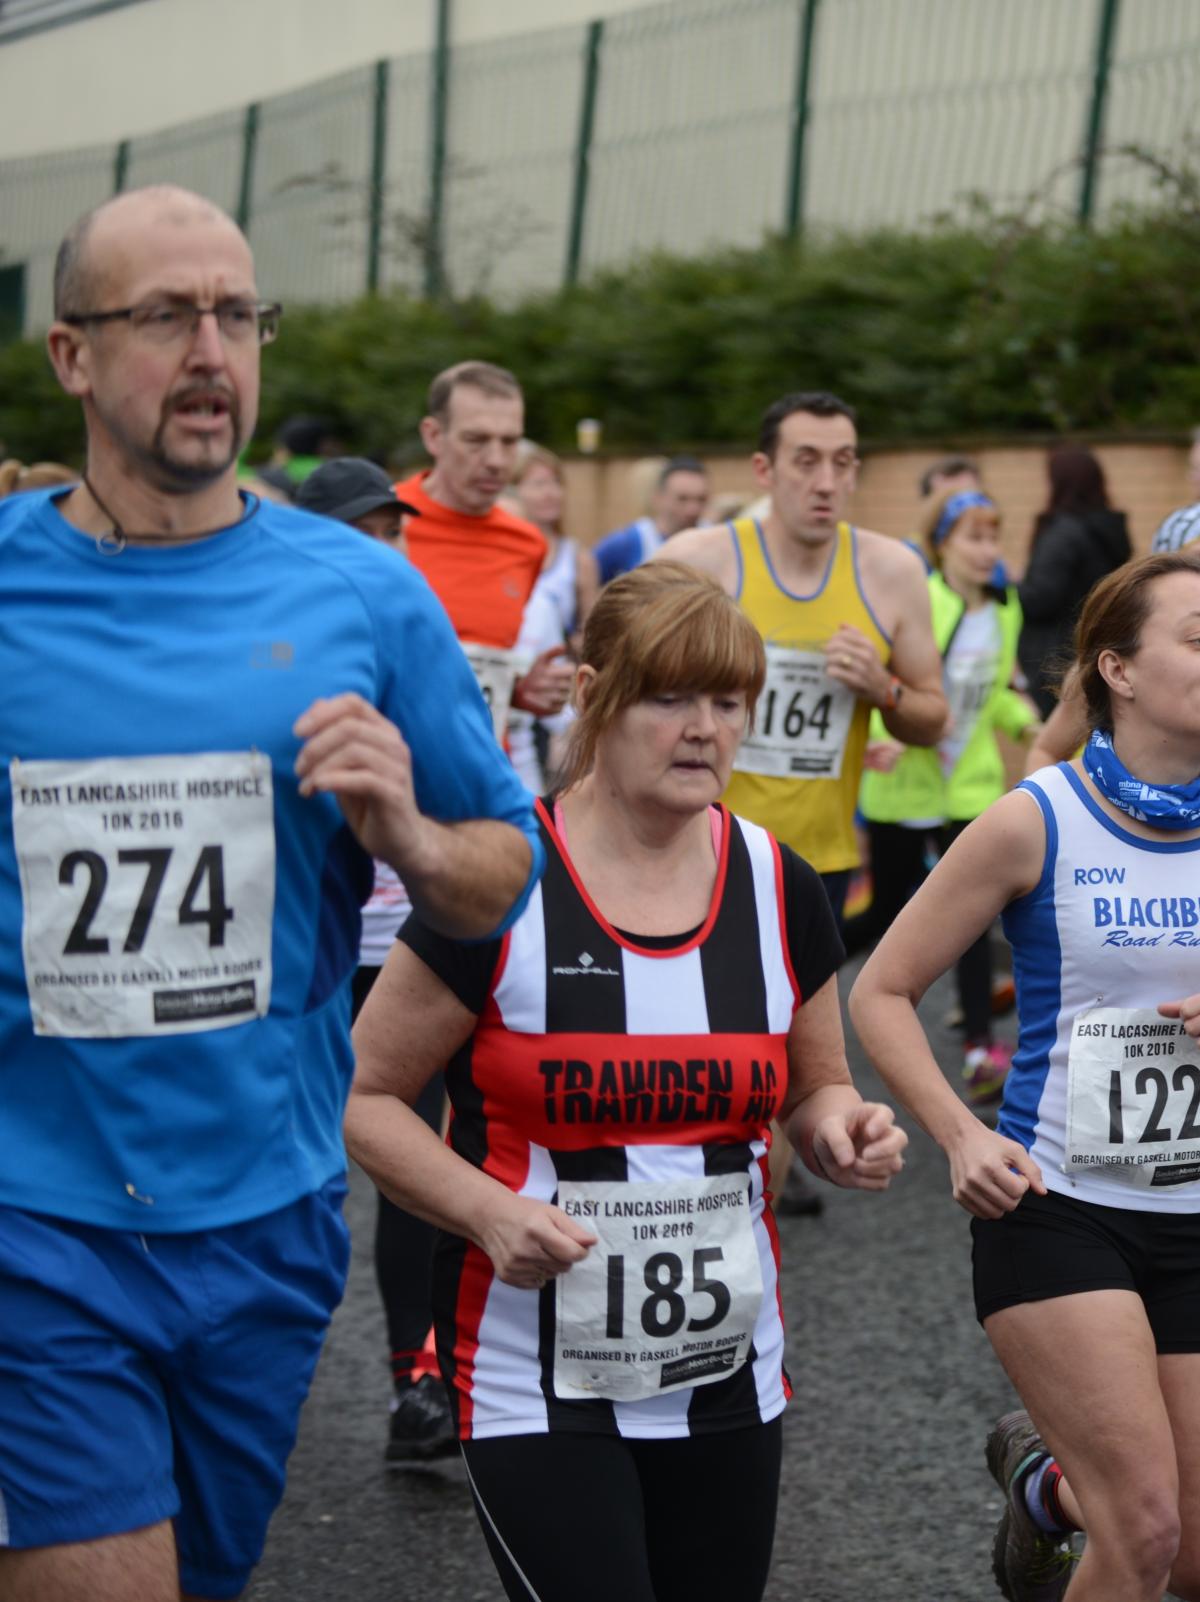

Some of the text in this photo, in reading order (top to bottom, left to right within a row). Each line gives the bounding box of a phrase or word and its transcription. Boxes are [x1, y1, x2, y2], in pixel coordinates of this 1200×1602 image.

[764, 689, 833, 740] 164
[21, 777, 265, 806] EAST LANCASHIRE HOSPICE
[103, 809, 184, 831] 10K 2016
[1074, 868, 1125, 885] ROW
[58, 845, 234, 956] 274
[1101, 930, 1165, 947] Road
[1077, 1024, 1108, 1037] EAST
[1124, 1042, 1175, 1058] 10K 2016
[539, 1059, 733, 1124] TRAWDEN
[1071, 1154, 1121, 1166] ORGANISED
[1124, 1156, 1134, 1165] BY
[1137, 1153, 1171, 1165] GASKELL
[1173, 1150, 1200, 1162] MOTOR
[565, 1190, 743, 1217] EAST LANCASHIRE HOSPICE
[632, 1222, 694, 1240] 10K 2016
[606, 1246, 732, 1339] 185
[562, 1332, 747, 1363] ORGANISED BY GASKELL MOTOR BODIES
